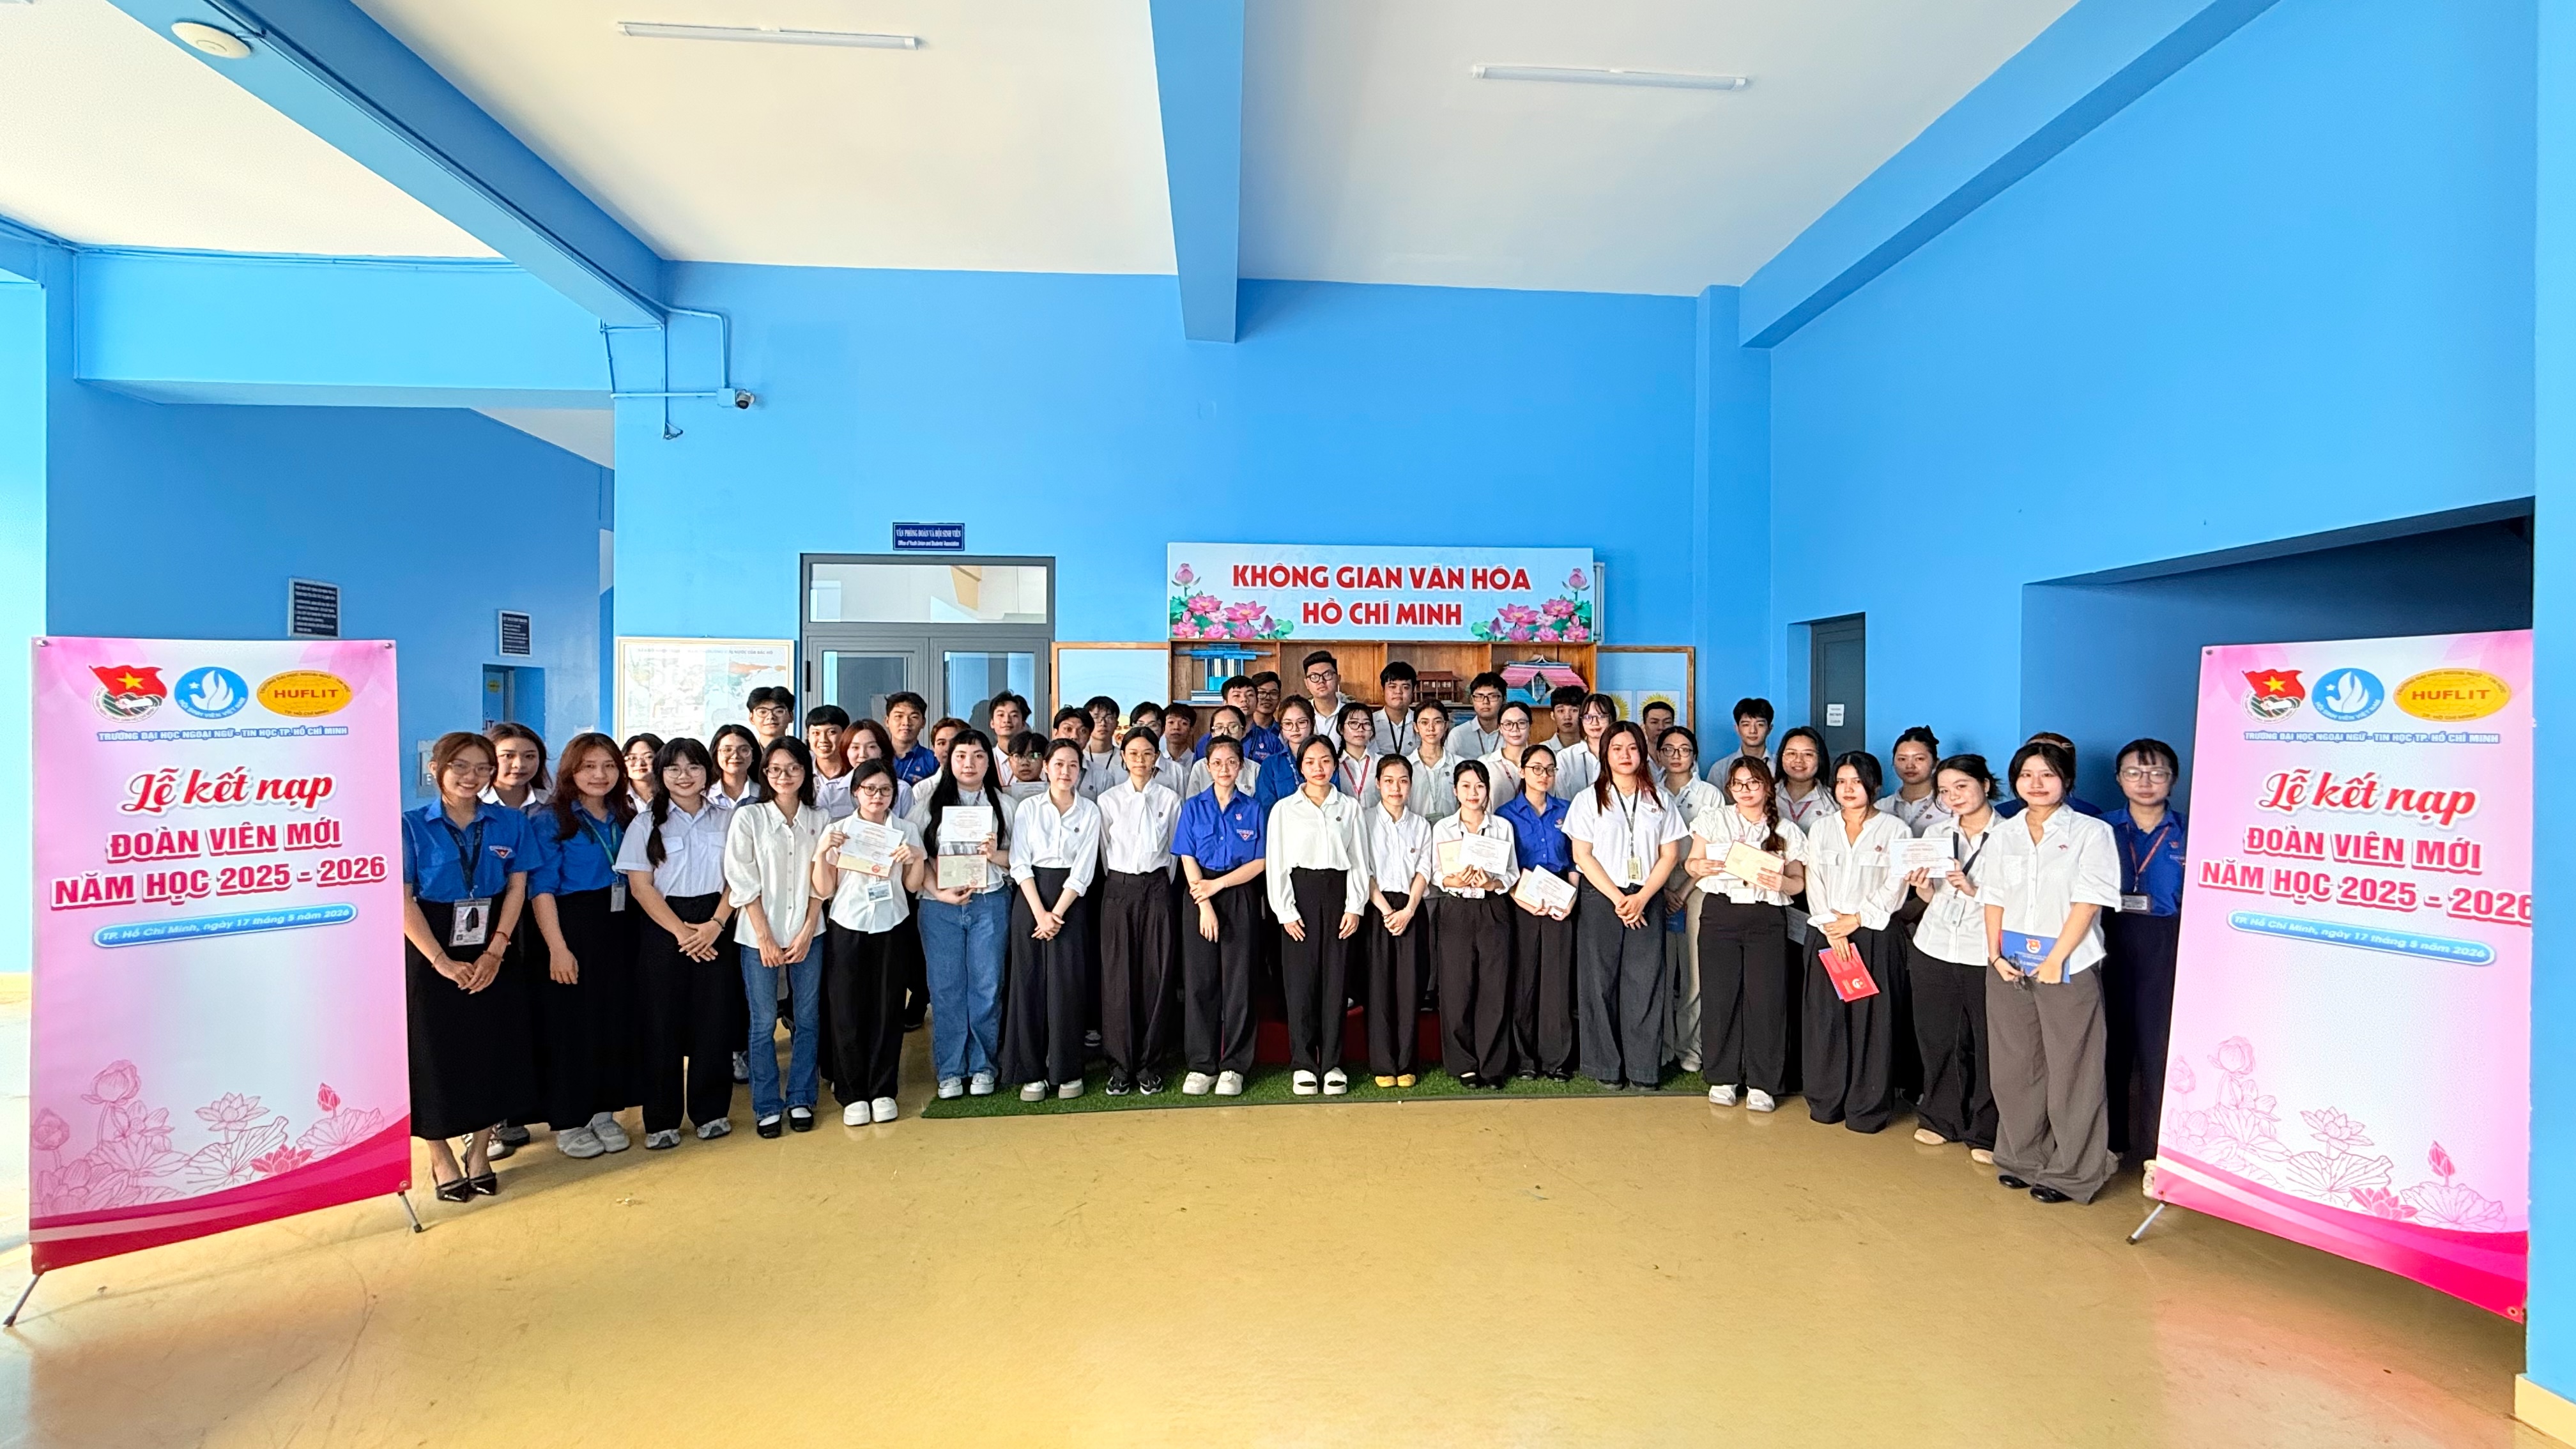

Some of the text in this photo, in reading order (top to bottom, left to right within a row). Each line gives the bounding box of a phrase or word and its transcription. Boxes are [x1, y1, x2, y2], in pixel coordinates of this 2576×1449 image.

[1234, 562, 1530, 590] KHÔNG GIAN VĂN HÓA
[1303, 597, 1461, 625] HỒ CHÍ MINH
[274, 689, 339, 698] HUFLIT
[2411, 689, 2491, 700] HUFLIT
[98, 730, 139, 740] TRƯỜNG
[160, 731, 180, 741] HỌC
[182, 730, 212, 740] NGOẠI
[241, 729, 257, 737] TIN
[259, 728, 278, 739] HỌC
[307, 726, 323, 735] CHÍ
[2296, 733, 2313, 742] HỌC
[2315, 733, 2343, 742] NGOẠI
[2374, 733, 2391, 742] TIN
[2391, 733, 2412, 744] HỌC
[2414, 733, 2428, 742] TP.
[2448, 733, 2467, 743] CHÍ
[2469, 734, 2499, 743] MINH
[121, 766, 333, 813] Lễ kết nạp
[2258, 769, 2476, 825] Lễ kết nạp
[109, 816, 341, 858] ĐOÀN VIÊN MỚI
[2246, 825, 2481, 870] ĐOÀN VIÊN MỚI
[55, 871, 134, 905] NĂM
[146, 869, 210, 900] HỌC
[220, 862, 291, 891] 2025
[319, 855, 385, 882] 2026
[2201, 859, 2265, 889] NĂM
[2273, 869, 2331, 899] HỌC
[2340, 876, 2417, 907] 2025
[2451, 887, 2531, 921] 2026
[203, 921, 233, 931] ngày
[253, 916, 284, 924] tháng
[288, 914, 296, 922] 5
[297, 912, 321, 921] năm
[324, 908, 349, 918] 2026
[2320, 928, 2352, 940] ngày
[2354, 931, 2369, 940] 17
[2370, 934, 2407, 949] tháng
[2409, 940, 2419, 949] 5
[2420, 942, 2451, 953] năm
[2452, 946, 2486, 958] 2026
